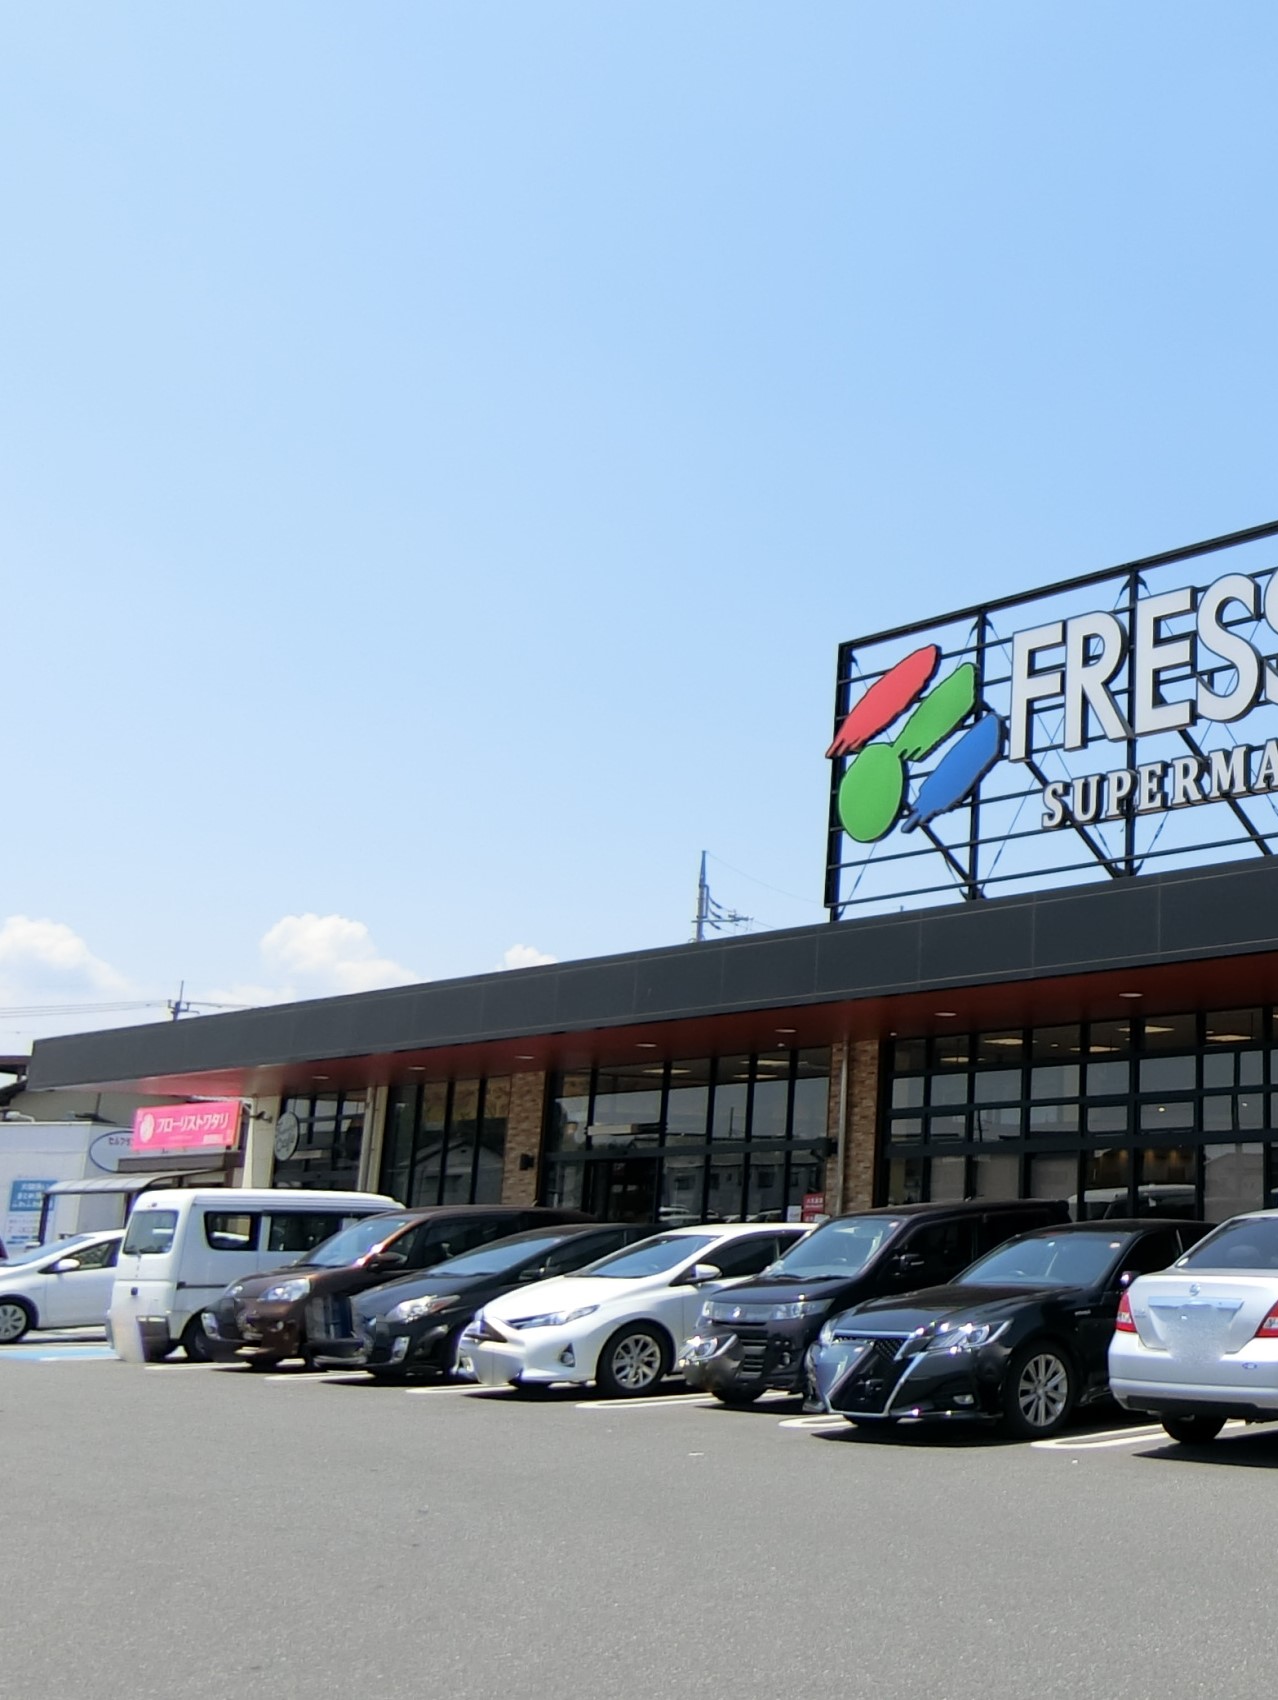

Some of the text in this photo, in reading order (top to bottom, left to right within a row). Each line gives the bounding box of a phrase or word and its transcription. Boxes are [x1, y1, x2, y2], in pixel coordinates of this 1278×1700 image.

[157, 1113, 229, 1133] フローリストワタリ
